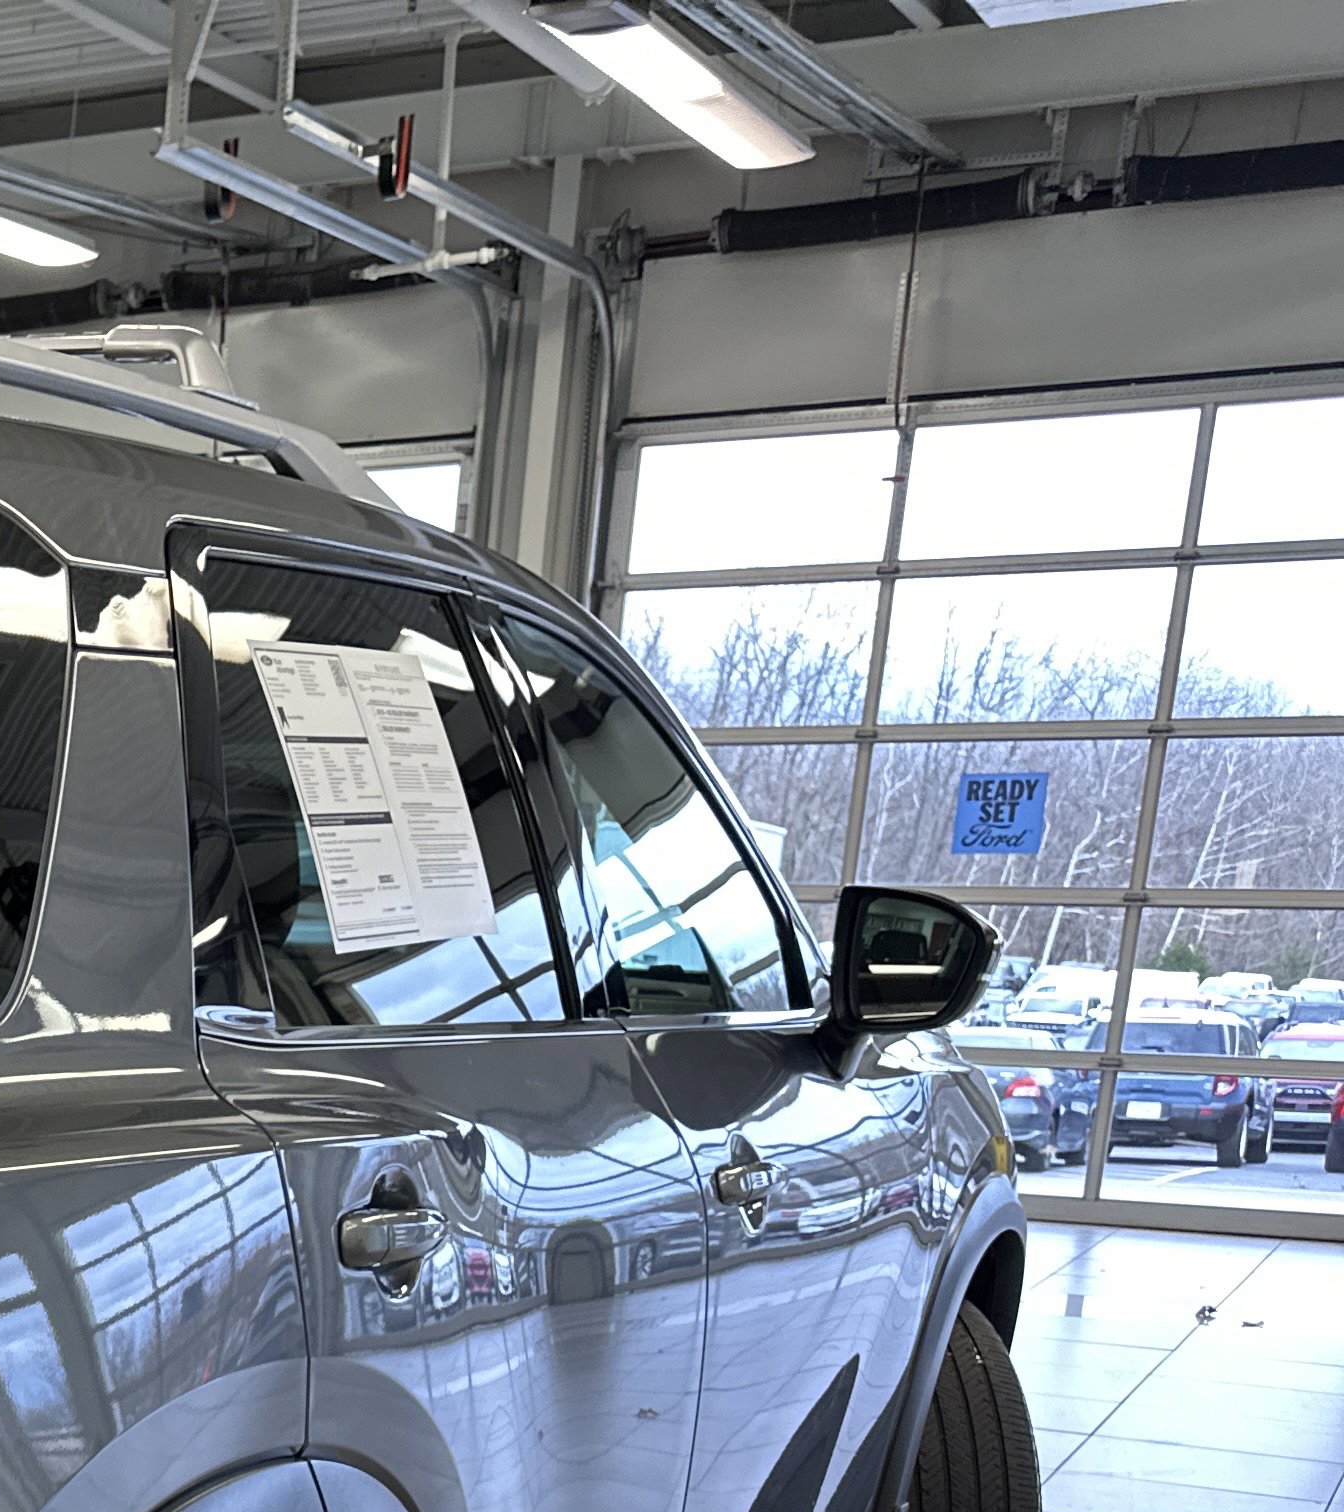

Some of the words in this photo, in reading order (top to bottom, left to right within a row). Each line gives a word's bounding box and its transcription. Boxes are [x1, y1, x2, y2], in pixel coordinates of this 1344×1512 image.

[966, 779, 1040, 801] READY
[979, 801, 1020, 823] SET
[961, 824, 1025, 848] Ford
